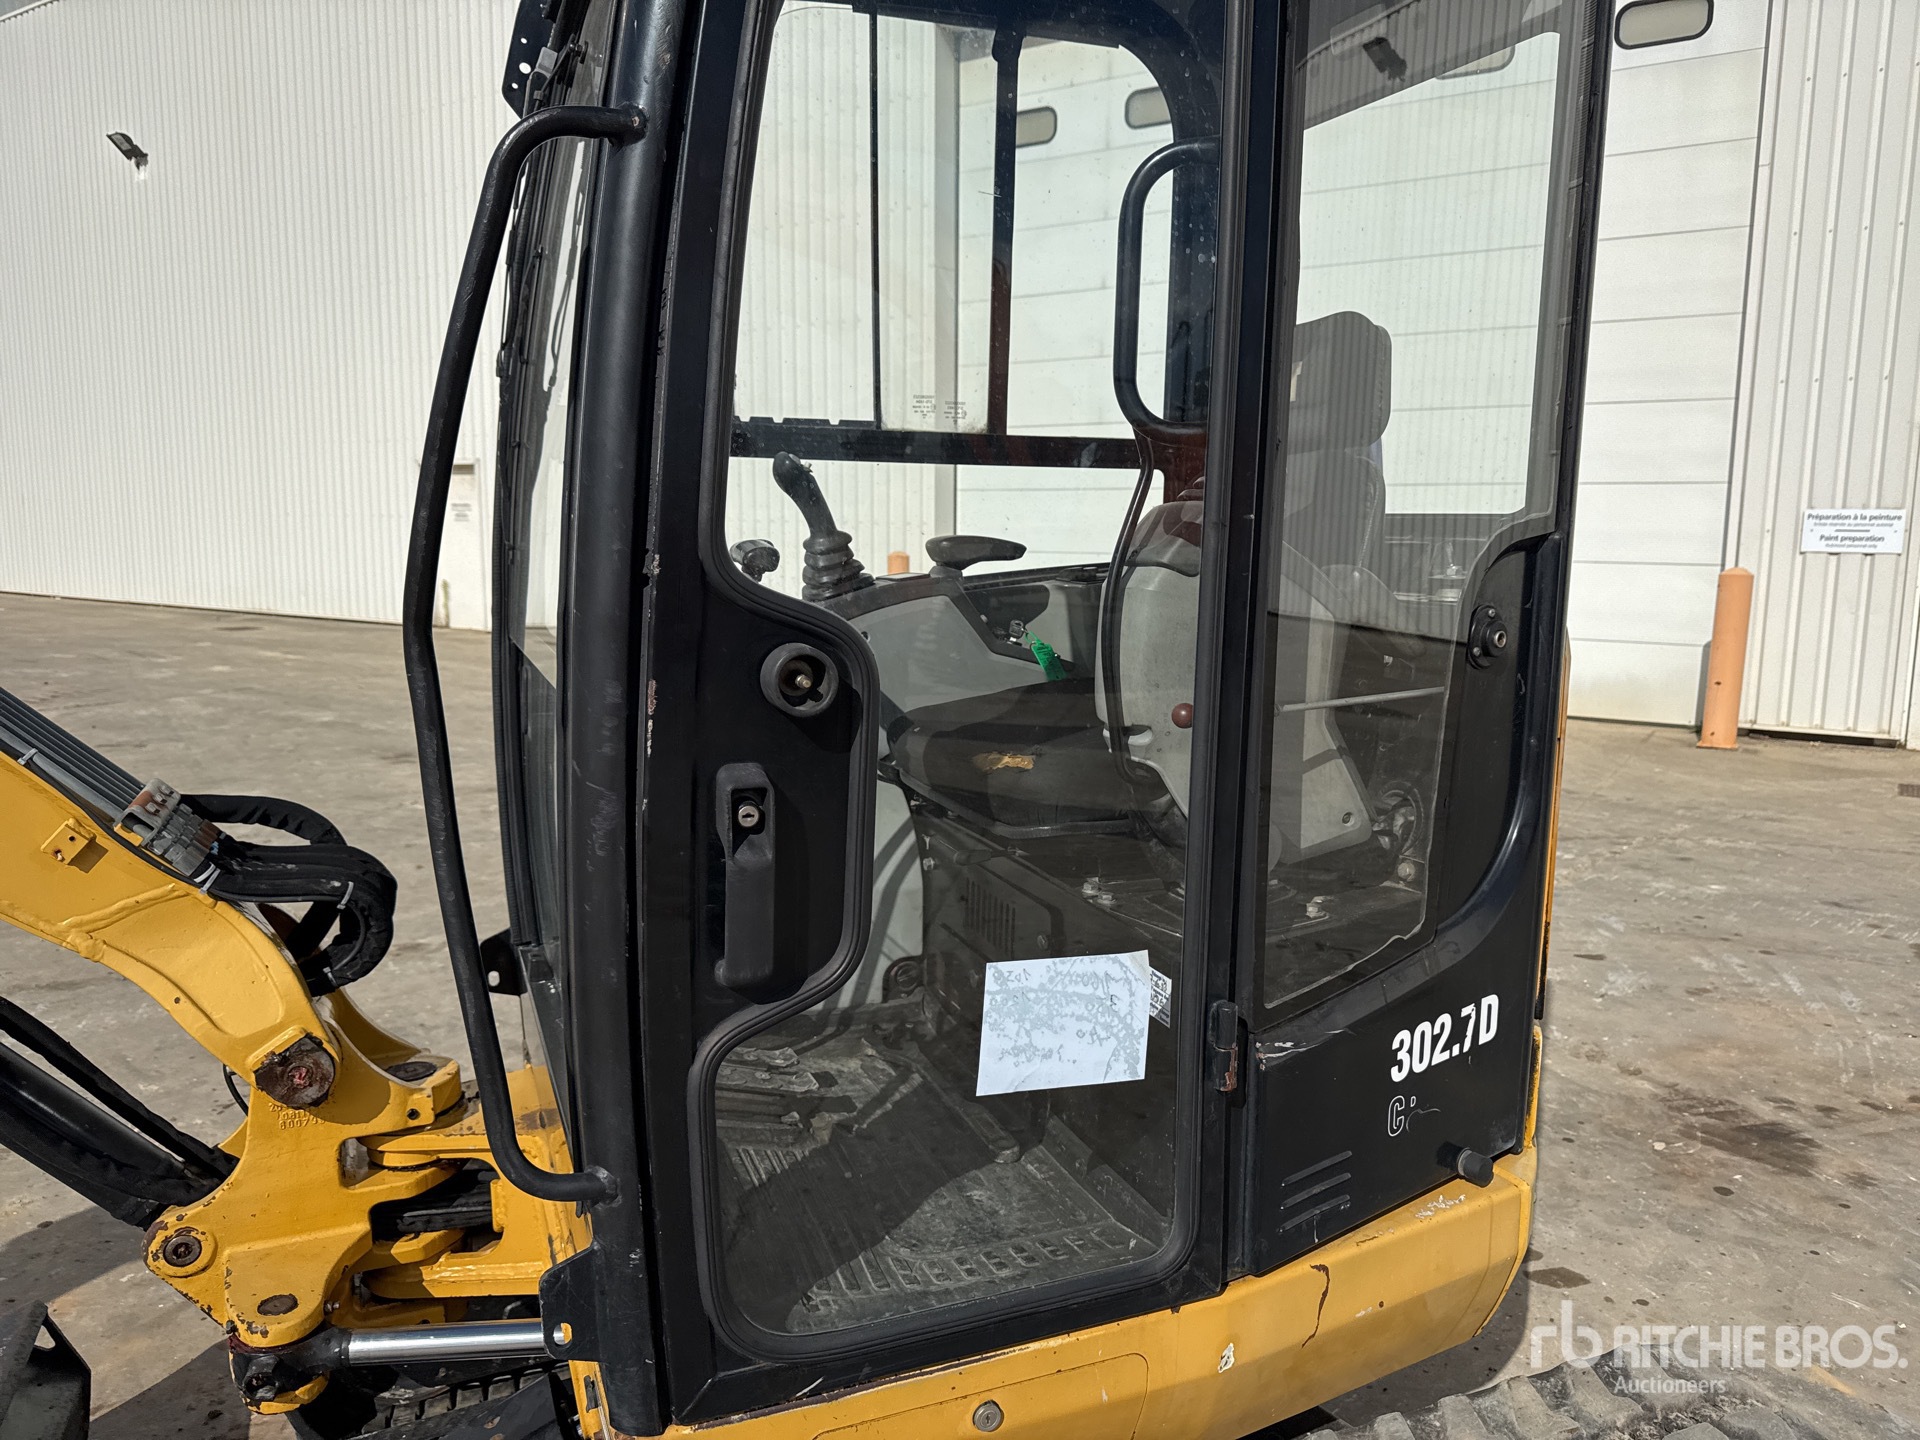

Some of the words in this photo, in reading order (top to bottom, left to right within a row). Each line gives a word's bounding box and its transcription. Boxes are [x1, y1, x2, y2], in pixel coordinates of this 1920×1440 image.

[1807, 512, 1851, 522] Préparation
[1852, 513, 1859, 521] à
[1860, 513, 1867, 521] la
[1868, 513, 1903, 522] peinture
[1820, 534, 1839, 542] Paint
[1840, 534, 1885, 543] preparation
[1390, 993, 1499, 1083] 302.7D
